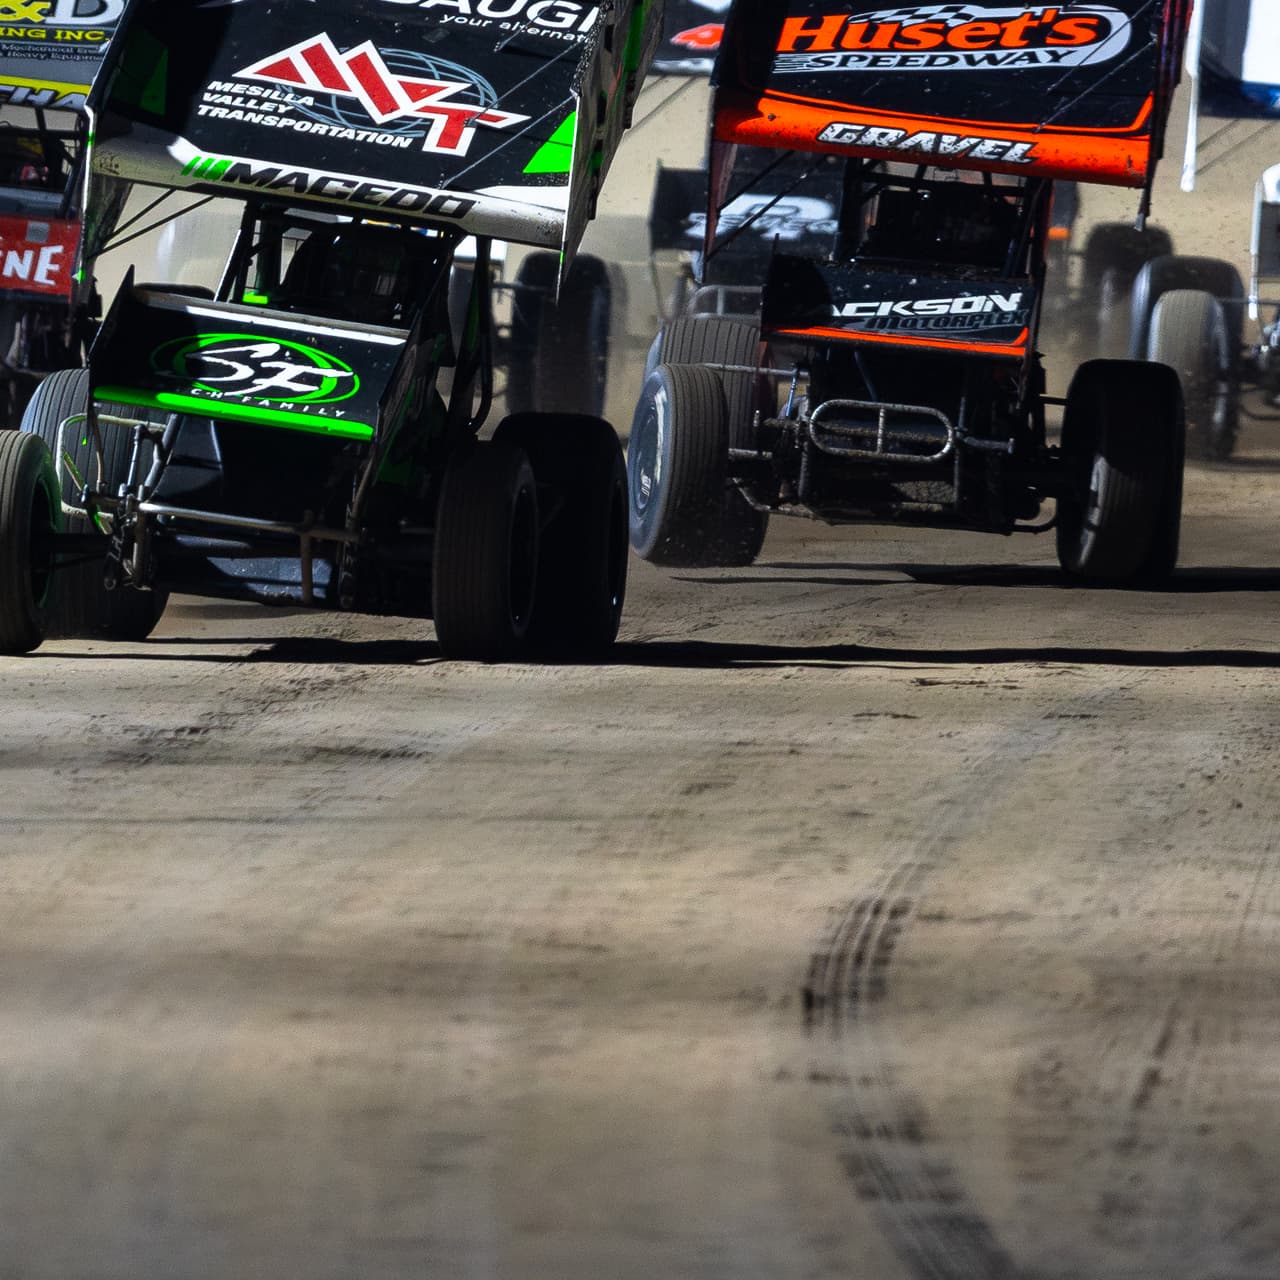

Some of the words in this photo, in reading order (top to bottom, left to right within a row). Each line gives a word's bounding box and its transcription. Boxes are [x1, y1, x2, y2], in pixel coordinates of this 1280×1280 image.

[439, 13, 494, 29] your
[777, 8, 1102, 51] Huset's
[54, 29, 111, 42] INC.
[807, 48, 1078, 69] SPEEDWAY
[202, 92, 296, 114] VALLEY
[207, 80, 314, 107] MESILLA
[197, 105, 414, 149] TRANSPORTATION
[818, 122, 1040, 165] GRAVEL
[221, 162, 477, 219] MACEDO
[242, 395, 347, 418] FAMILY
